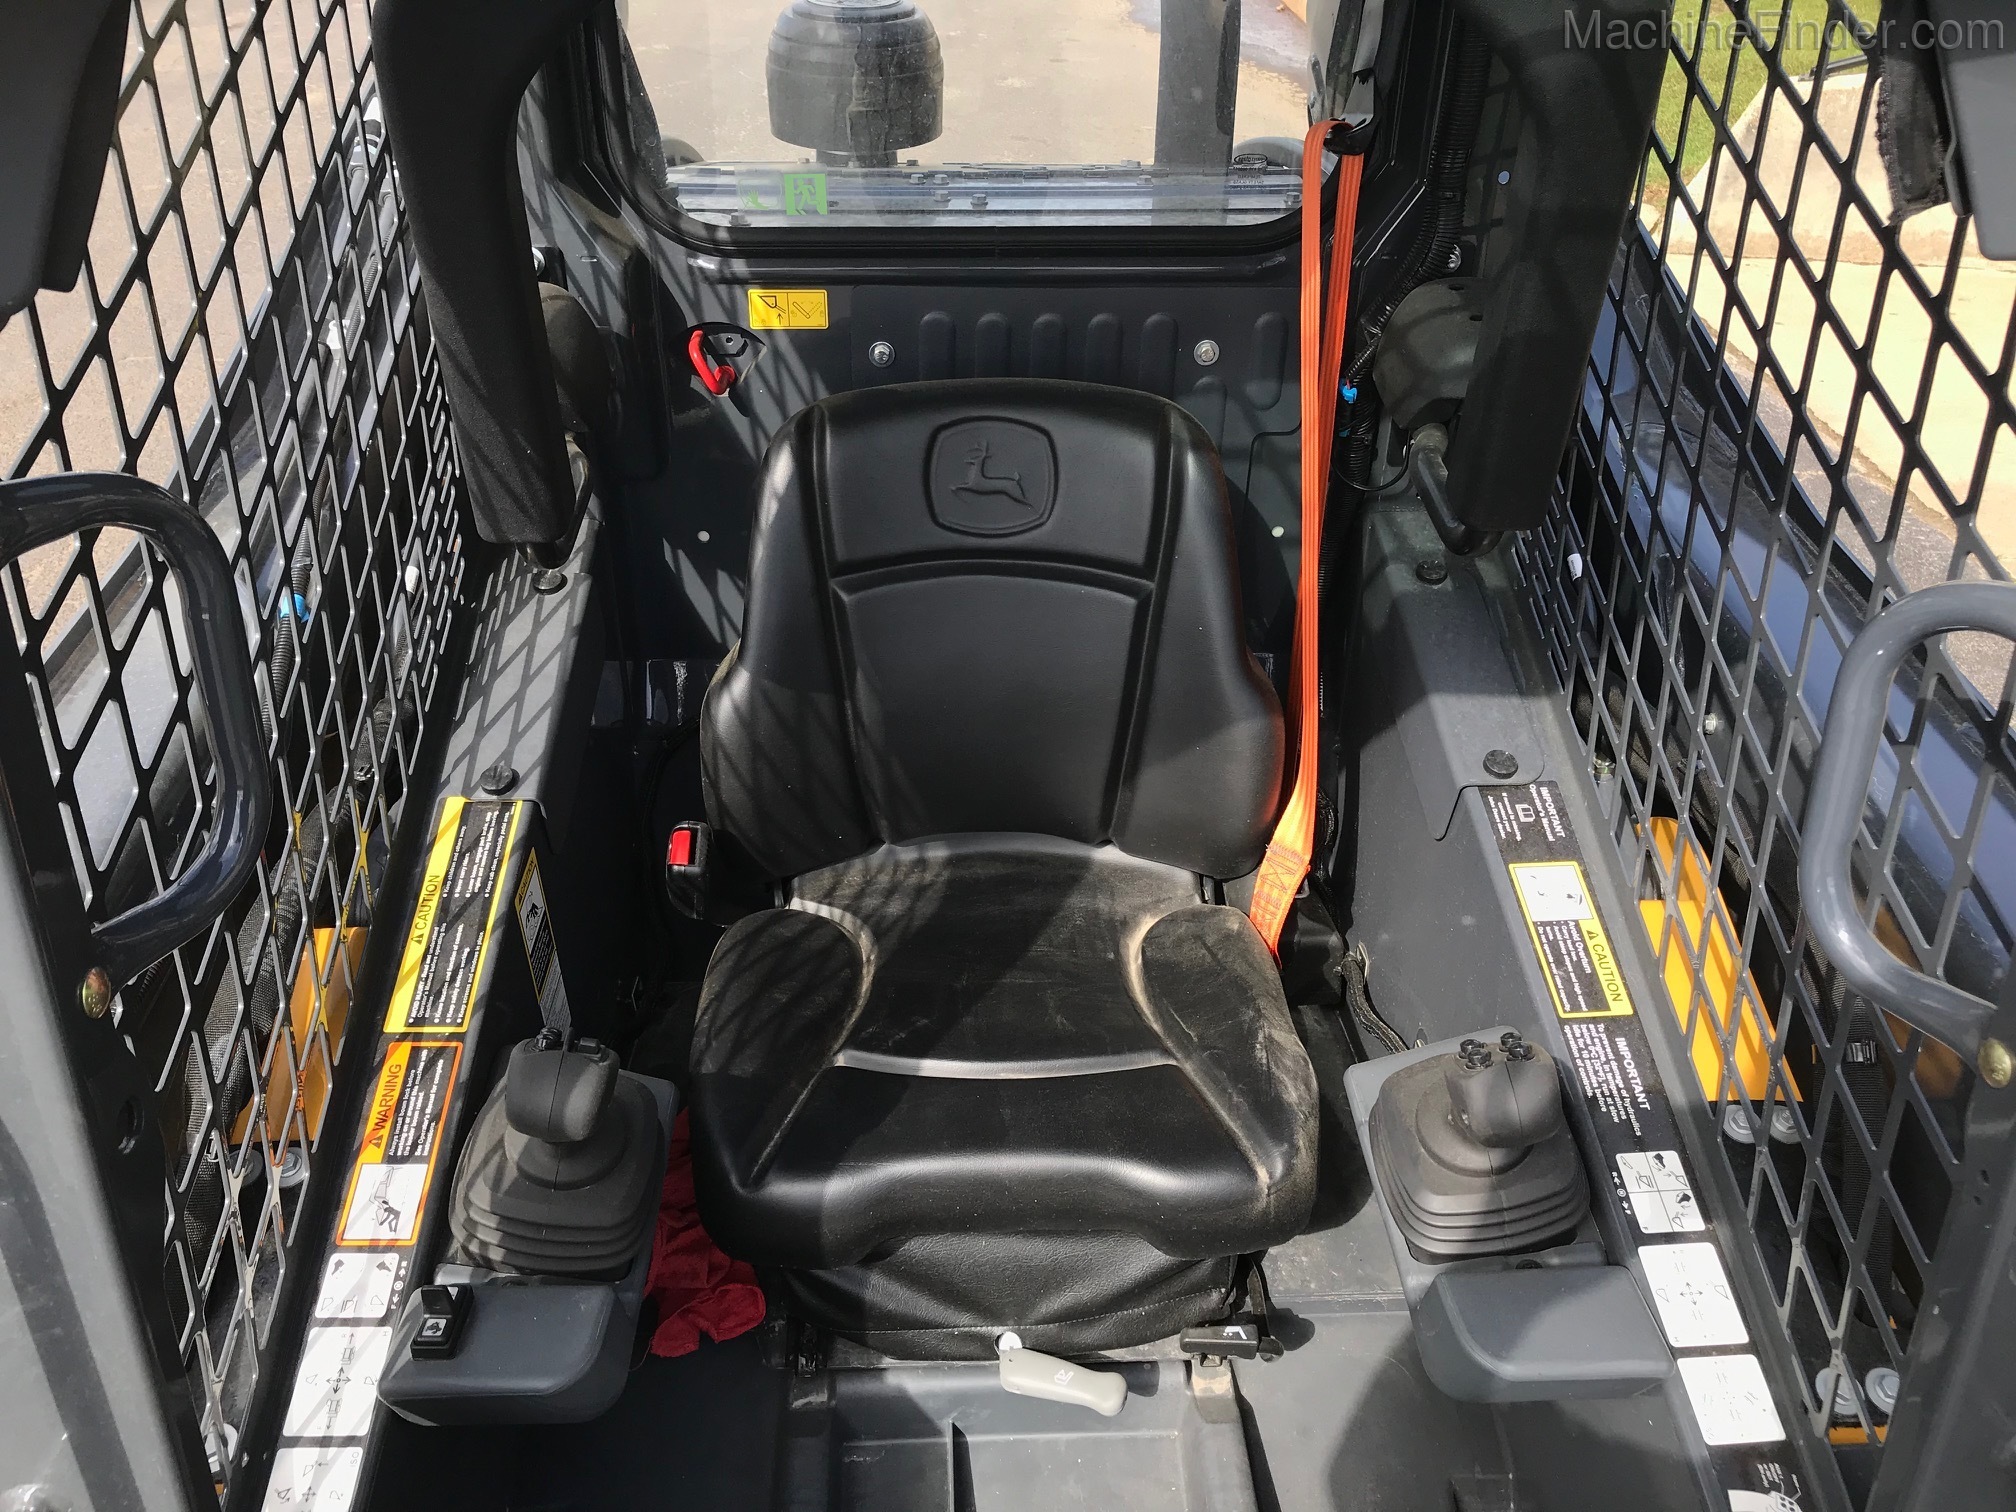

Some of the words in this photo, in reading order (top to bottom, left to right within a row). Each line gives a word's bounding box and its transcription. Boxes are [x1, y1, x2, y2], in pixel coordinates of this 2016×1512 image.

[486, 828, 494, 841] before
[490, 810, 499, 827] leaving.
[1492, 809, 1500, 822] Deere
[1497, 823, 1506, 839] dealer.
[1498, 802, 1507, 820] contact
[1503, 821, 1511, 832] your
[1503, 797, 1514, 814] manual
[1530, 784, 1545, 817] Operator's
[1542, 818, 1555, 841] Manual
[1540, 787, 1565, 837] IMPORTANT
[444, 881, 452, 892] Keep
[448, 862, 456, 880] children
[459, 826, 467, 837] away.
[455, 879, 463, 892] Never
[462, 852, 470, 866] riders.
[471, 864, 479, 878] boom,
[475, 847, 483, 863] engage
[481, 822, 489, 835] brake,
[485, 881, 493, 892] Keep
[491, 858, 499, 871] clean,
[495, 835, 504, 857] especially
[414, 875, 440, 930] CAUTION
[1561, 926, 1569, 939] Carry
[1567, 940, 1575, 950] load
[1568, 921, 1581, 941] Avoid
[1576, 942, 1591, 973] Overturn
[411, 1001, 419, 1017] AVOID
[415, 981, 424, 1000] INJURY
[421, 966, 429, 977] Read
[429, 927, 439, 954] understand
[417, 992, 428, 1017] Operator's
[424, 973, 433, 990] Manual
[429, 957, 438, 971] before
[435, 933, 445, 955] operating
[435, 1003, 443, 1017] Know
[439, 982, 448, 1002] location
[447, 951, 457, 971] function
[455, 924, 464, 944] controls.
[447, 1005, 455, 1017] Keep
[451, 988, 459, 1003] safety
[455, 969, 463, 987] devices
[461, 947, 470, 967] working.
[458, 1005, 466, 1017] Keep
[463, 984, 471, 1003] screens
[470, 951, 479, 972] windows
[1544, 944, 1553, 962] operate
[1550, 963, 1558, 974] over
[1555, 975, 1563, 988] rated
[1560, 989, 1570, 1012] capacity.
[1553, 926, 1563, 939] Avoid
[1559, 941, 1567, 954] steep
[1564, 955, 1573, 971] slopes
[1570, 973, 1578, 982] and
[1574, 983, 1582, 994] high
[1578, 995, 1588, 1011] speed
[1591, 944, 1623, 1002] CAUTION
[425, 995, 434, 1017] machine.
[1597, 1023, 1605, 1032] To
[1564, 1025, 1579, 1057] operation
[1579, 1068, 1593, 1098] controls.
[1572, 1025, 1581, 1037] idle
[1577, 1038, 1585, 1048] for
[1581, 1050, 1589, 1058] 10
[1585, 1060, 1598, 1087] minutes
[1595, 1089, 1607, 1111] before
[1581, 1024, 1592, 1044] below
[1601, 1084, 1610, 1095] run
[1609, 1106, 1619, 1122] slow
[1589, 1024, 1598, 1037] and
[1594, 1038, 1606, 1063] engine,
[1606, 1073, 1626, 1119] temperatures
[1600, 1033, 1615, 1059] prevent
[1610, 1061, 1624, 1088] damage
[1616, 1038, 1650, 1109] IMPORTANT
[372, 1065, 402, 1131] WARNING
[389, 1135, 398, 1155] Always
[394, 1117, 403, 1134] install
[399, 1100, 407, 1116] boom
[406, 1070, 415, 1086] before
[397, 1133, 408, 1155] working
[407, 1097, 416, 1116] around
[415, 1062, 425, 1084] machine
[406, 1127, 415, 1145] loader
[411, 1111, 419, 1126] boom
[416, 1091, 424, 1109] raised.
[418, 1115, 430, 1143] Operator's
[425, 1094, 435, 1113] Manual
[434, 1060, 443, 1084] complete
[1621, 1089, 1629, 1097] of
[1624, 1098, 1641, 1135] hydraulics
[422, 1121, 435, 1155] instructions.
[350, 1452, 359, 1468] ISO
